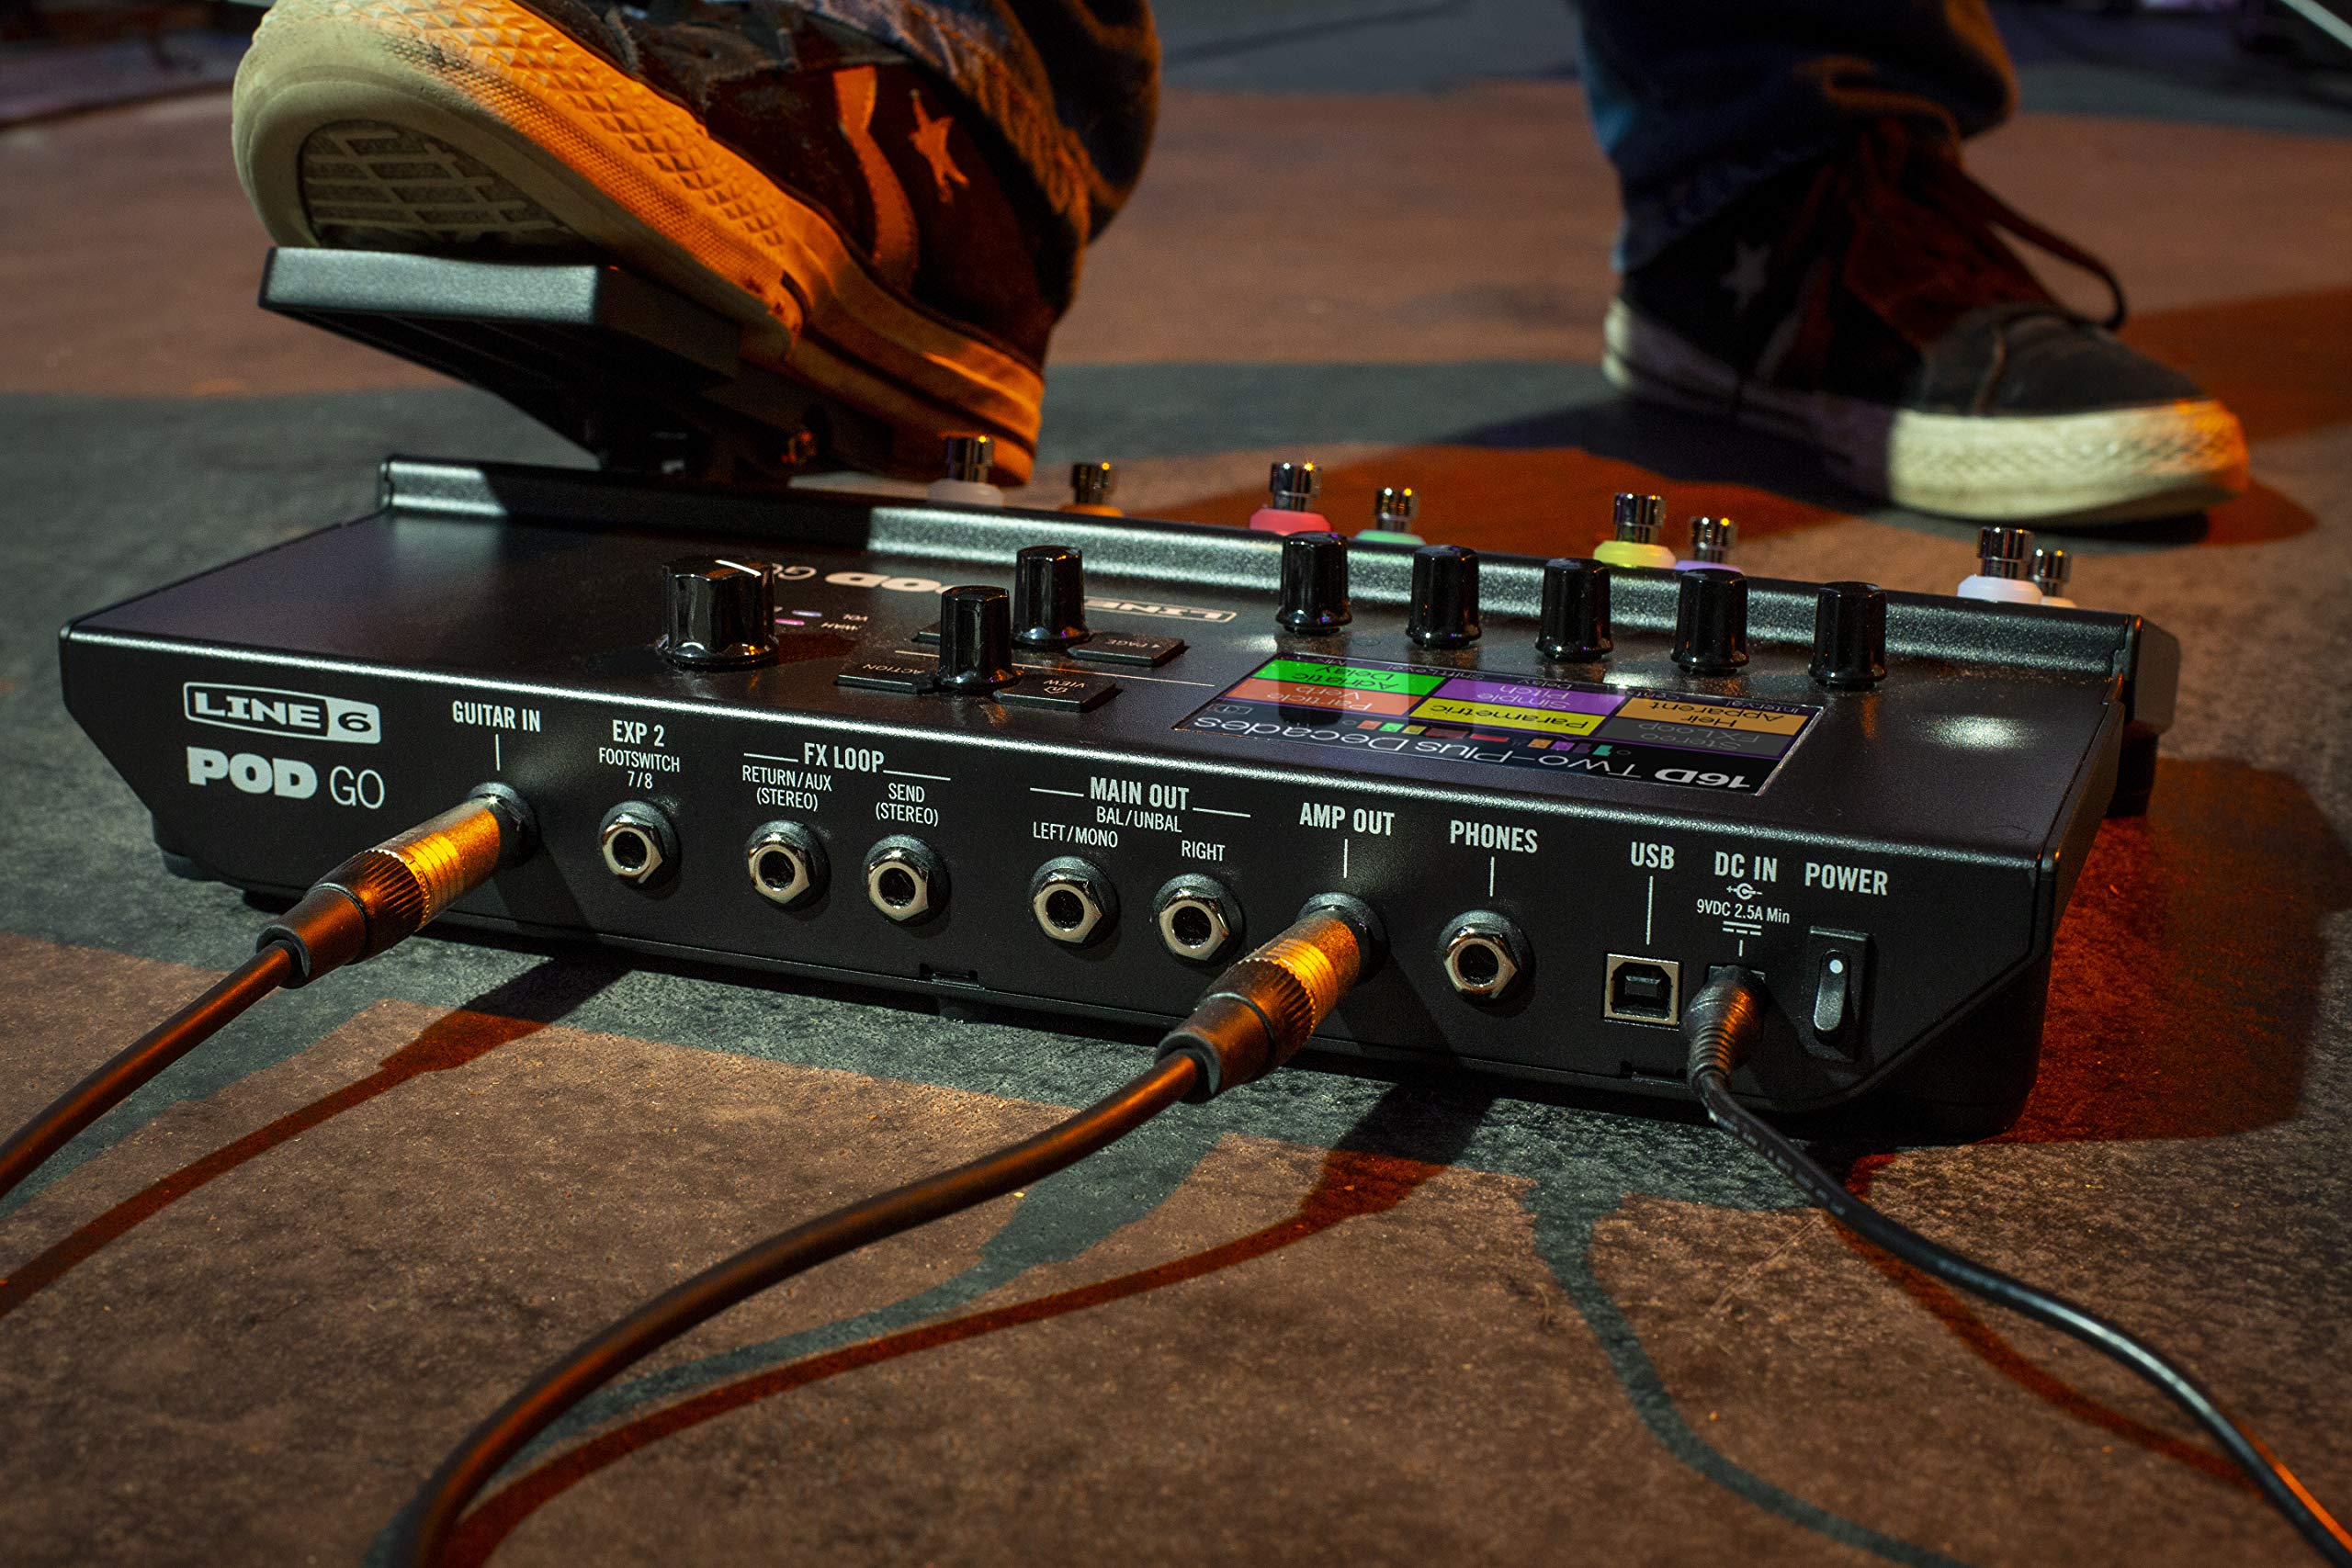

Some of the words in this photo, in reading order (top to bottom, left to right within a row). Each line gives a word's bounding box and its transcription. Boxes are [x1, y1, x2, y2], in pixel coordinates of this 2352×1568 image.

[825, 571, 956, 594] OD
[862, 662, 926, 675] ACTION
[1292, 671, 1400, 691] Adriatic
[1315, 666, 1395, 682] Delay
[1042, 679, 1086, 689] VIEW
[1295, 686, 1362, 701] Verb
[1498, 684, 1570, 700] Pitch
[1519, 678, 1573, 691] Delay
[194, 691, 322, 729] LINE
[337, 711, 373, 733] 6
[1266, 692, 1373, 711] Particle
[1476, 692, 1572, 710] Simple
[1650, 701, 1785, 723] Apparent
[1724, 699, 1800, 714] Interval
[452, 700, 516, 729] GUITAR
[521, 708, 541, 733] IN
[1430, 705, 1589, 729] Parametric
[1680, 714, 1737, 728] Heir
[612, 718, 648, 745] EXP
[653, 724, 665, 748] 2
[1193, 716, 1410, 751] Decades
[1641, 732, 1742, 750] Stereo
[598, 747, 681, 773] FOOTSWITCH
[803, 741, 829, 768] FX
[833, 745, 885, 773] LOOP
[186, 746, 318, 799] POD
[329, 765, 385, 810] GO
[627, 770, 653, 790] 7/8
[741, 764, 832, 792] RETURN/AUX
[1655, 768, 1751, 789] 16D
[756, 786, 820, 813] (STEREO)
[888, 782, 925, 804] SEND
[1090, 776, 1144, 809] MAIN
[1148, 783, 1190, 811] OUT
[875, 801, 939, 828] (STEREO)
[1095, 806, 1183, 834] BAL/UNBAL
[1299, 802, 1346, 829] AMP
[1352, 807, 1396, 837] OUT
[1033, 821, 1119, 849] LEFT/MONO
[1450, 819, 1538, 853] PHONES
[1181, 840, 1226, 862] RIGHT
[1630, 841, 1675, 870] USB
[1713, 851, 1746, 878] DC
[1753, 855, 1778, 883] IN
[1804, 862, 1888, 896] POWER
[1695, 898, 1732, 917] 9VDC
[1735, 899, 1764, 921] 2.5A
[1766, 907, 1791, 924] Min
